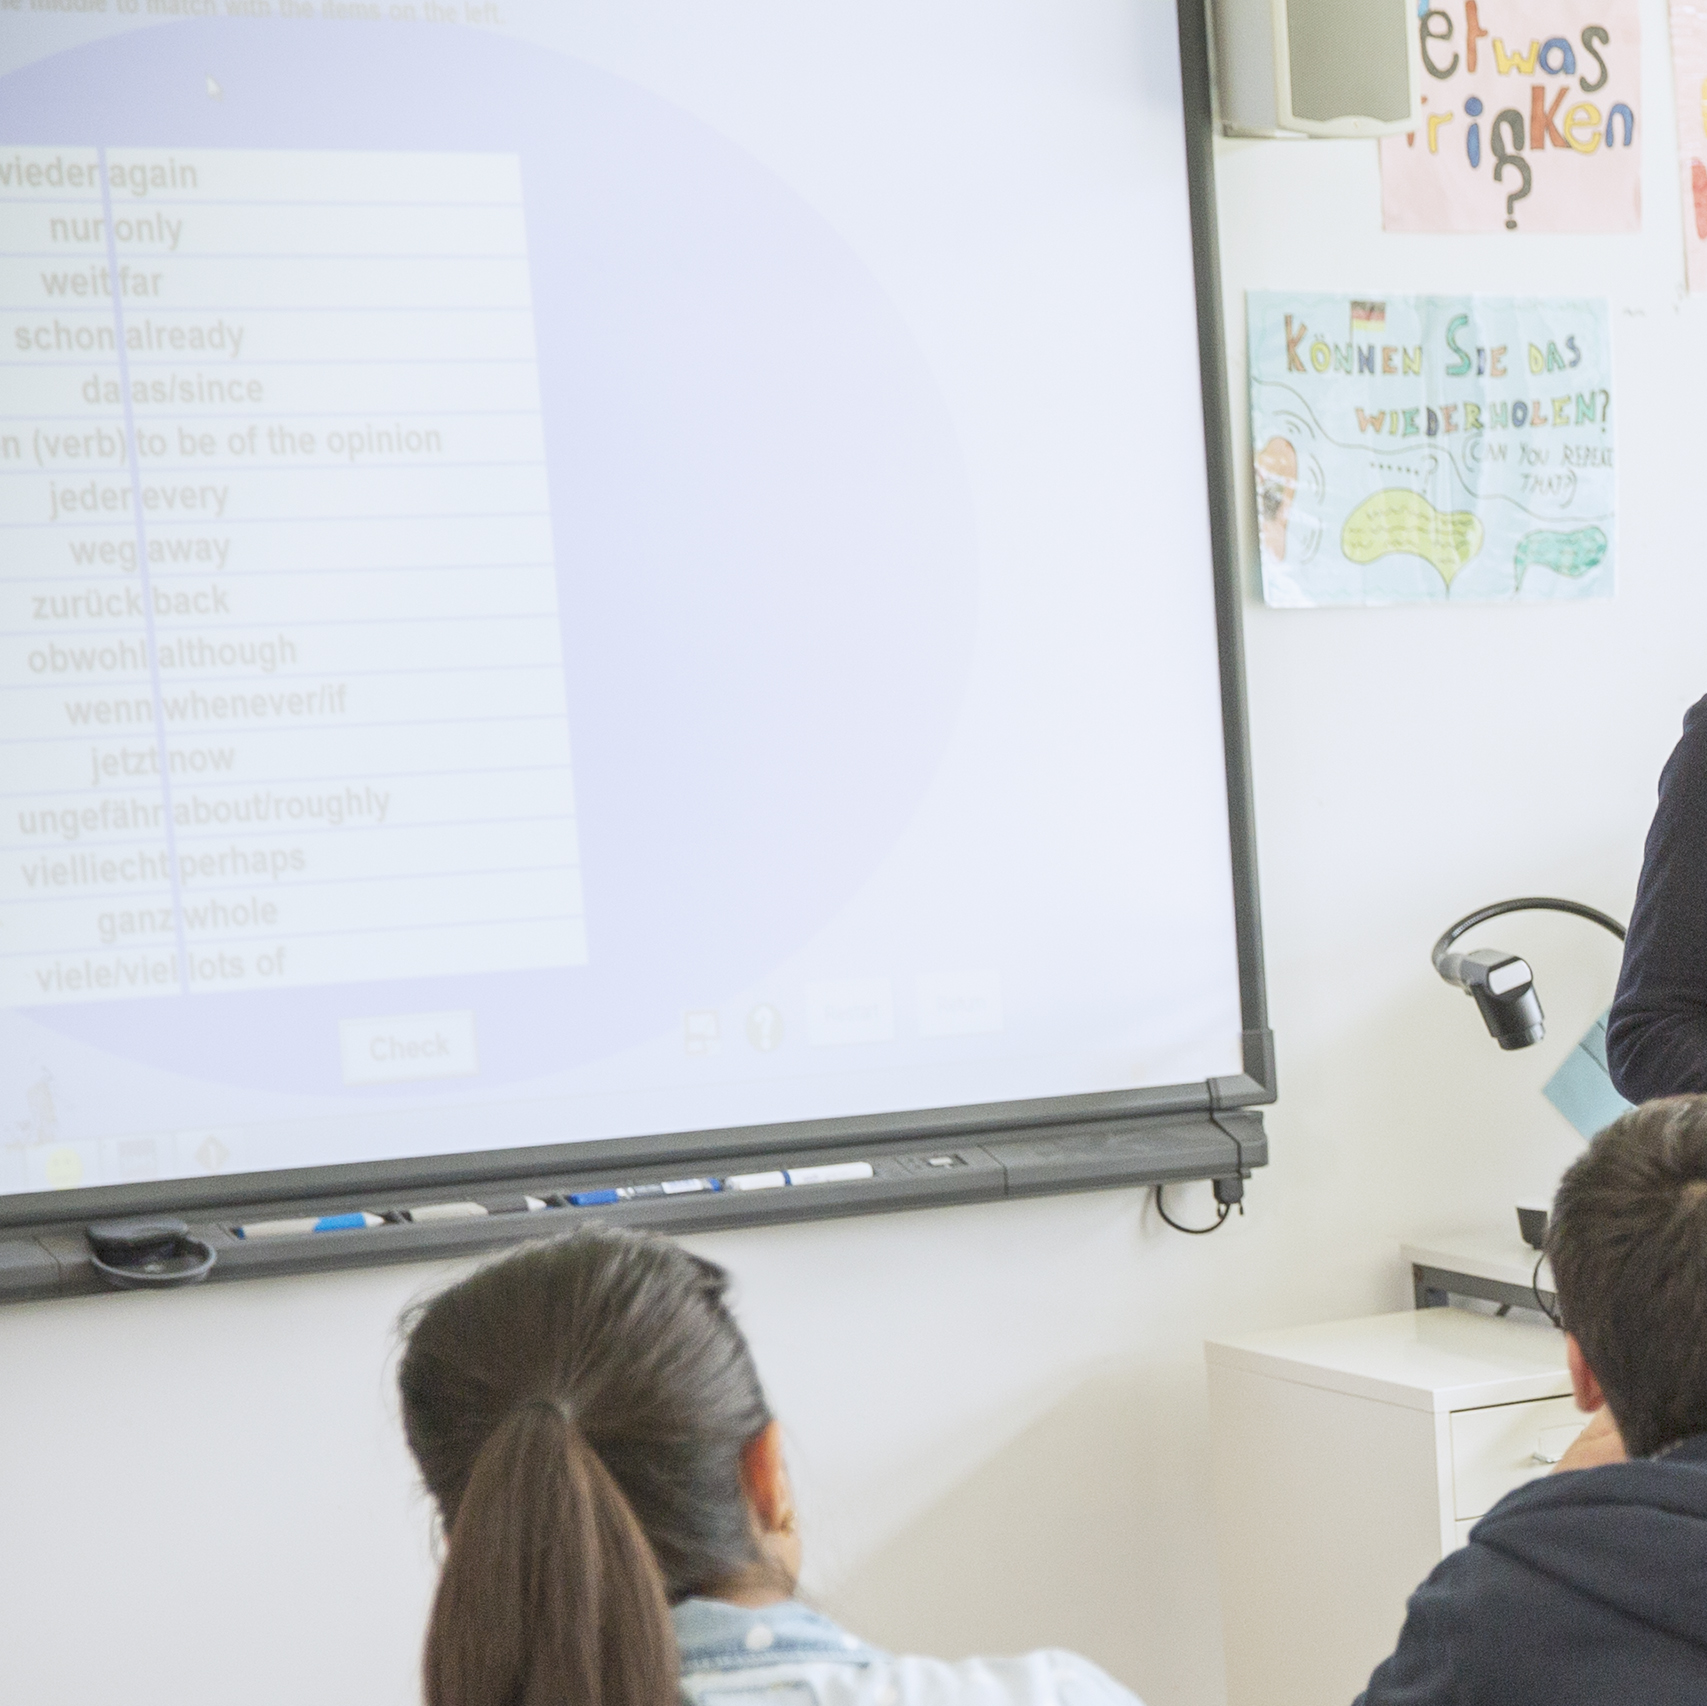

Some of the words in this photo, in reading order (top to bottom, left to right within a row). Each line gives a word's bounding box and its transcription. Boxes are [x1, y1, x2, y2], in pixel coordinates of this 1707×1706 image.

[109, 158, 198, 197] again
[50, 217, 106, 242] nur
[114, 212, 183, 250] only
[41, 266, 112, 297] weit
[117, 266, 164, 297] far
[14, 320, 115, 351] schon
[125, 320, 244, 358] already
[1284, 313, 1423, 375] KÖNNEN
[1527, 335, 1583, 376] DAS
[82, 375, 120, 404] da
[132, 374, 264, 404] as/since
[1355, 388, 1611, 437] WIEDERHOLEN?
[33, 428, 129, 467] (verb)
[136, 429, 167, 458] to
[179, 427, 216, 457] be
[228, 426, 258, 456] of
[268, 425, 316, 455] the
[327, 423, 442, 460] opinion
[50, 481, 132, 519] jeder
[142, 483, 229, 516] every
[70, 539, 137, 571] weg
[148, 537, 230, 568] away
[32, 586, 144, 620] zurück
[154, 584, 230, 615] back
[28, 639, 148, 673] obwohl
[158, 634, 297, 671] although
[65, 699, 152, 726] wenn
[162, 684, 348, 720] whenever/if
[91, 746, 161, 785] jetzt
[168, 746, 235, 773] now
[18, 799, 165, 840] ungefähr
[174, 787, 390, 826] about/roughly
[179, 846, 306, 884] perhaps
[98, 907, 175, 942] ganz
[183, 896, 279, 929] whole
[36, 954, 180, 993] viele/viel
[189, 951, 245, 983] lots
[256, 947, 286, 976] of
[369, 1032, 450, 1062] Check
